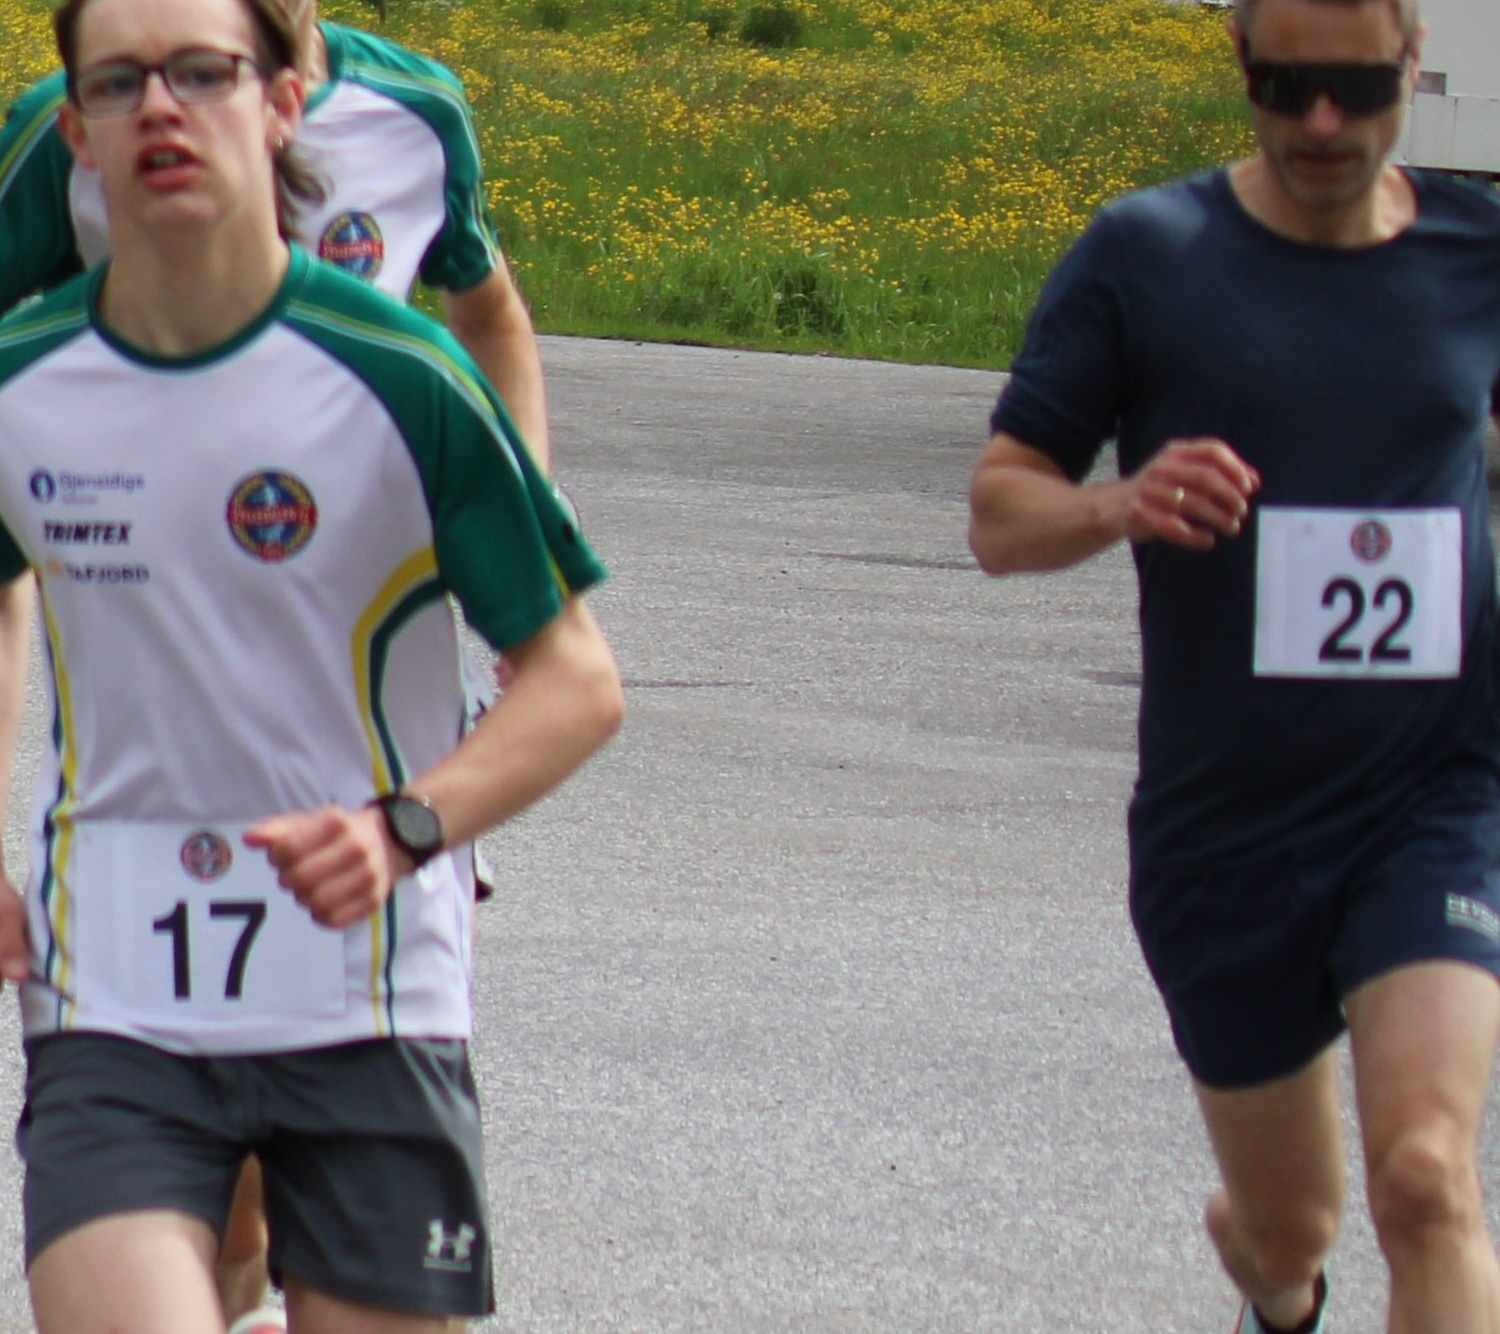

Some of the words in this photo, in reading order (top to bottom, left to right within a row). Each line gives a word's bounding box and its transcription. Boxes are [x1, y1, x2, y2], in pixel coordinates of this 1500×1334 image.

[44, 520, 132, 546] TRIMTEX
[1318, 578, 1414, 664] 22
[152, 900, 267, 1002] 17
